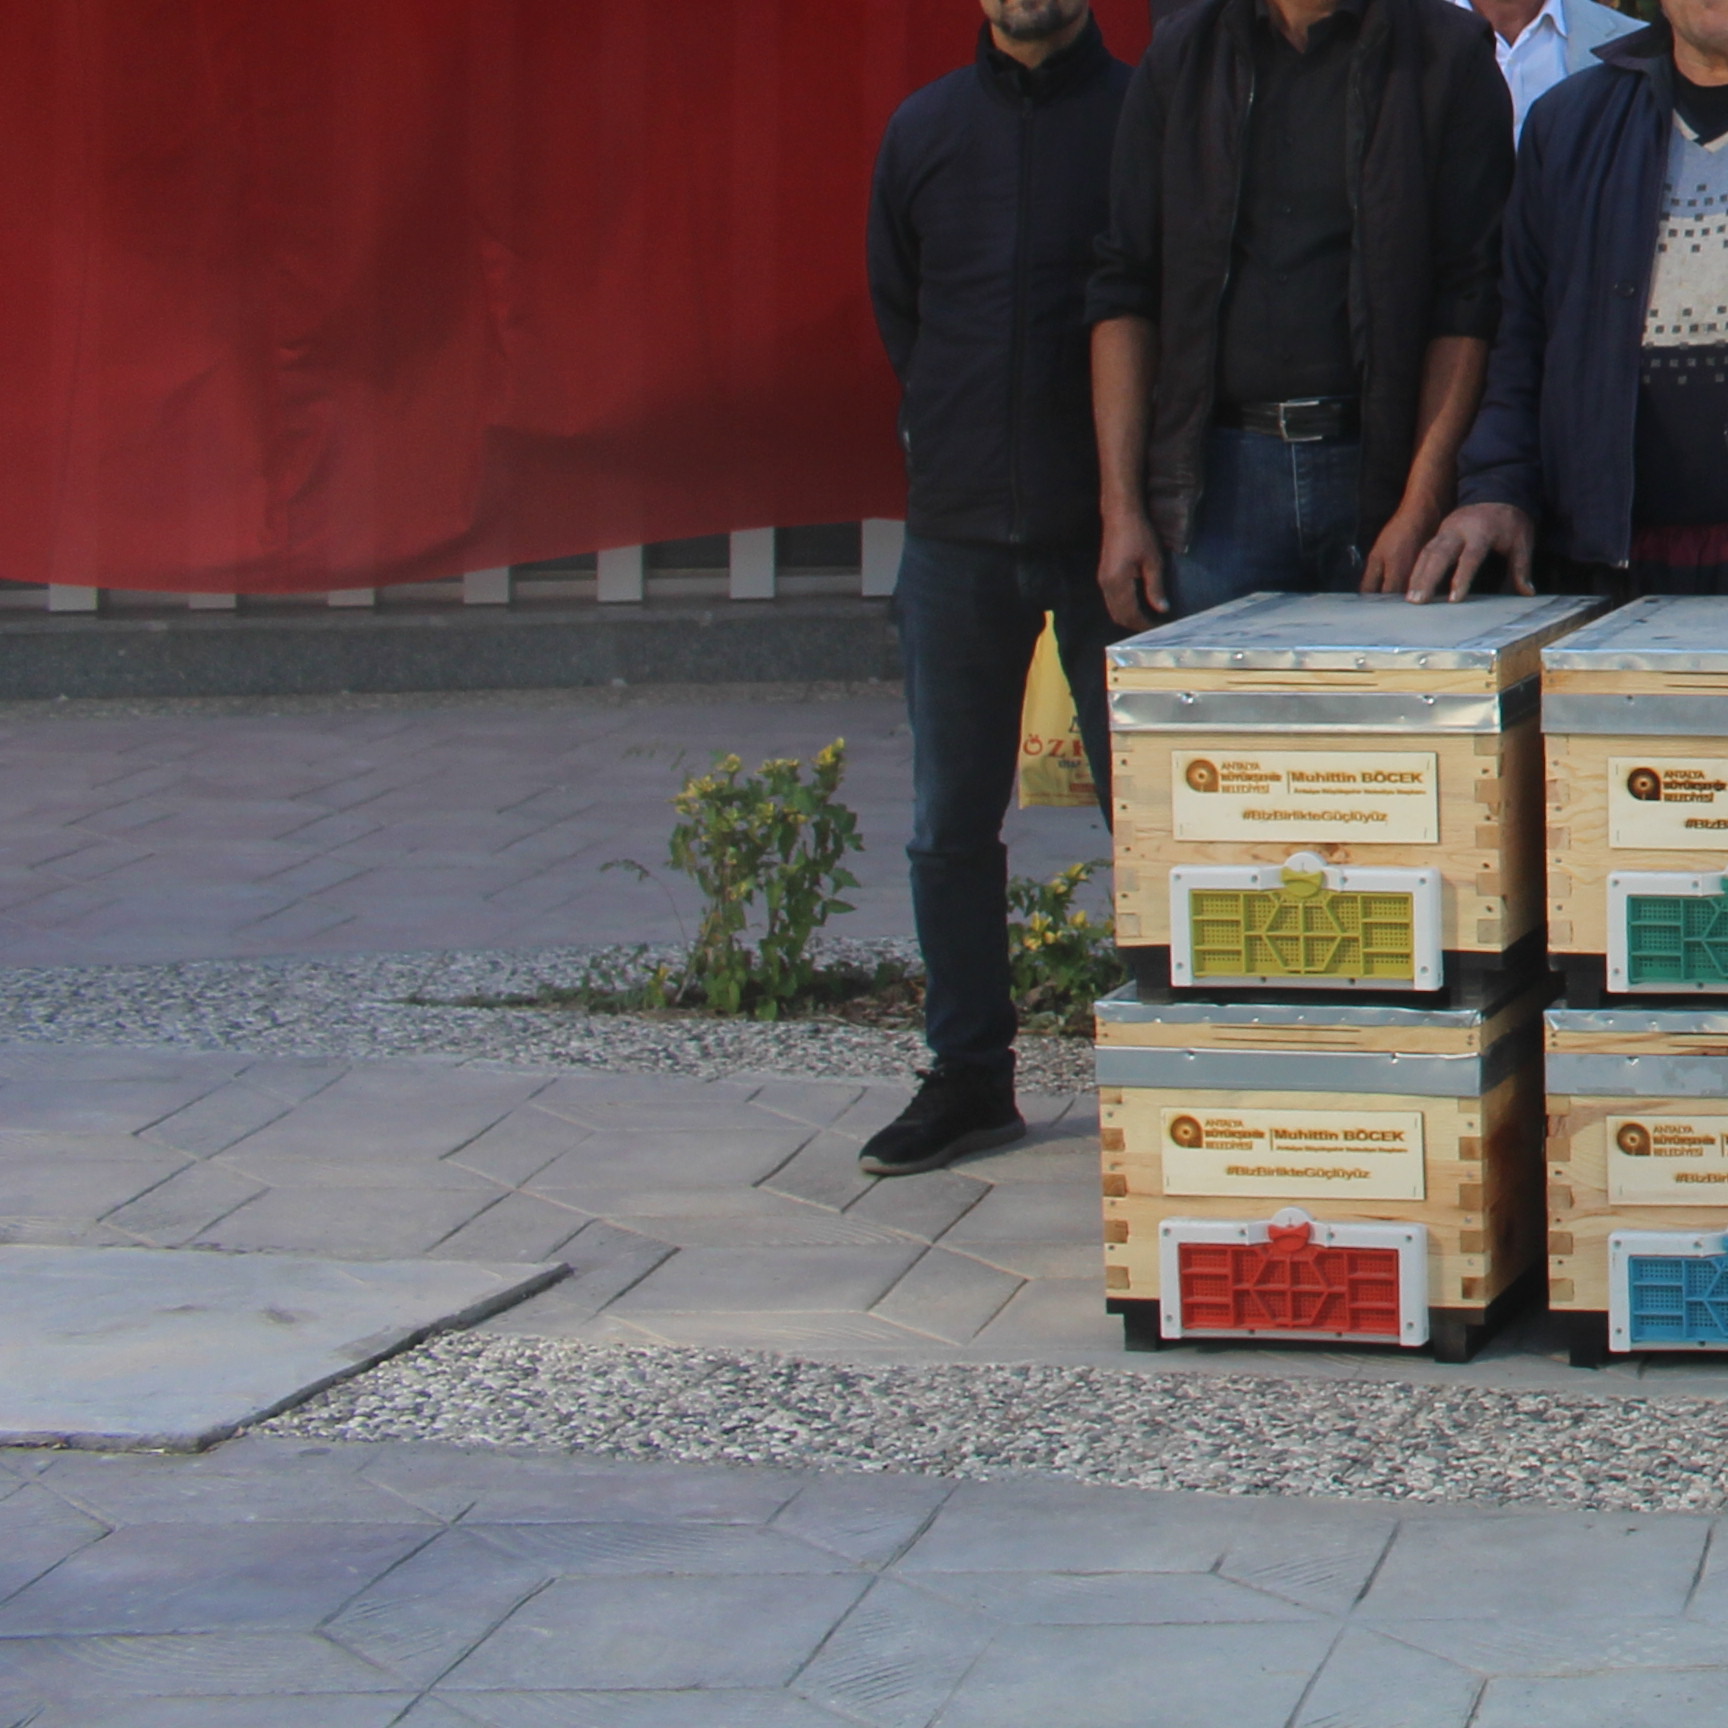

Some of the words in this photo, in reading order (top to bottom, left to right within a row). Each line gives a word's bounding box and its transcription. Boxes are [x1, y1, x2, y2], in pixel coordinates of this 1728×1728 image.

[1291, 770, 1357, 783] Muhittin
[1361, 769, 1423, 783] BÖCEK
[1242, 809, 1388, 823] #BizBirlikteGüçlüyüz
[1274, 1127, 1339, 1141] Muhittin
[1344, 1128, 1404, 1142] BÖCEK
[1226, 1165, 1370, 1180] #BizBirlikteGüçlüyüz
